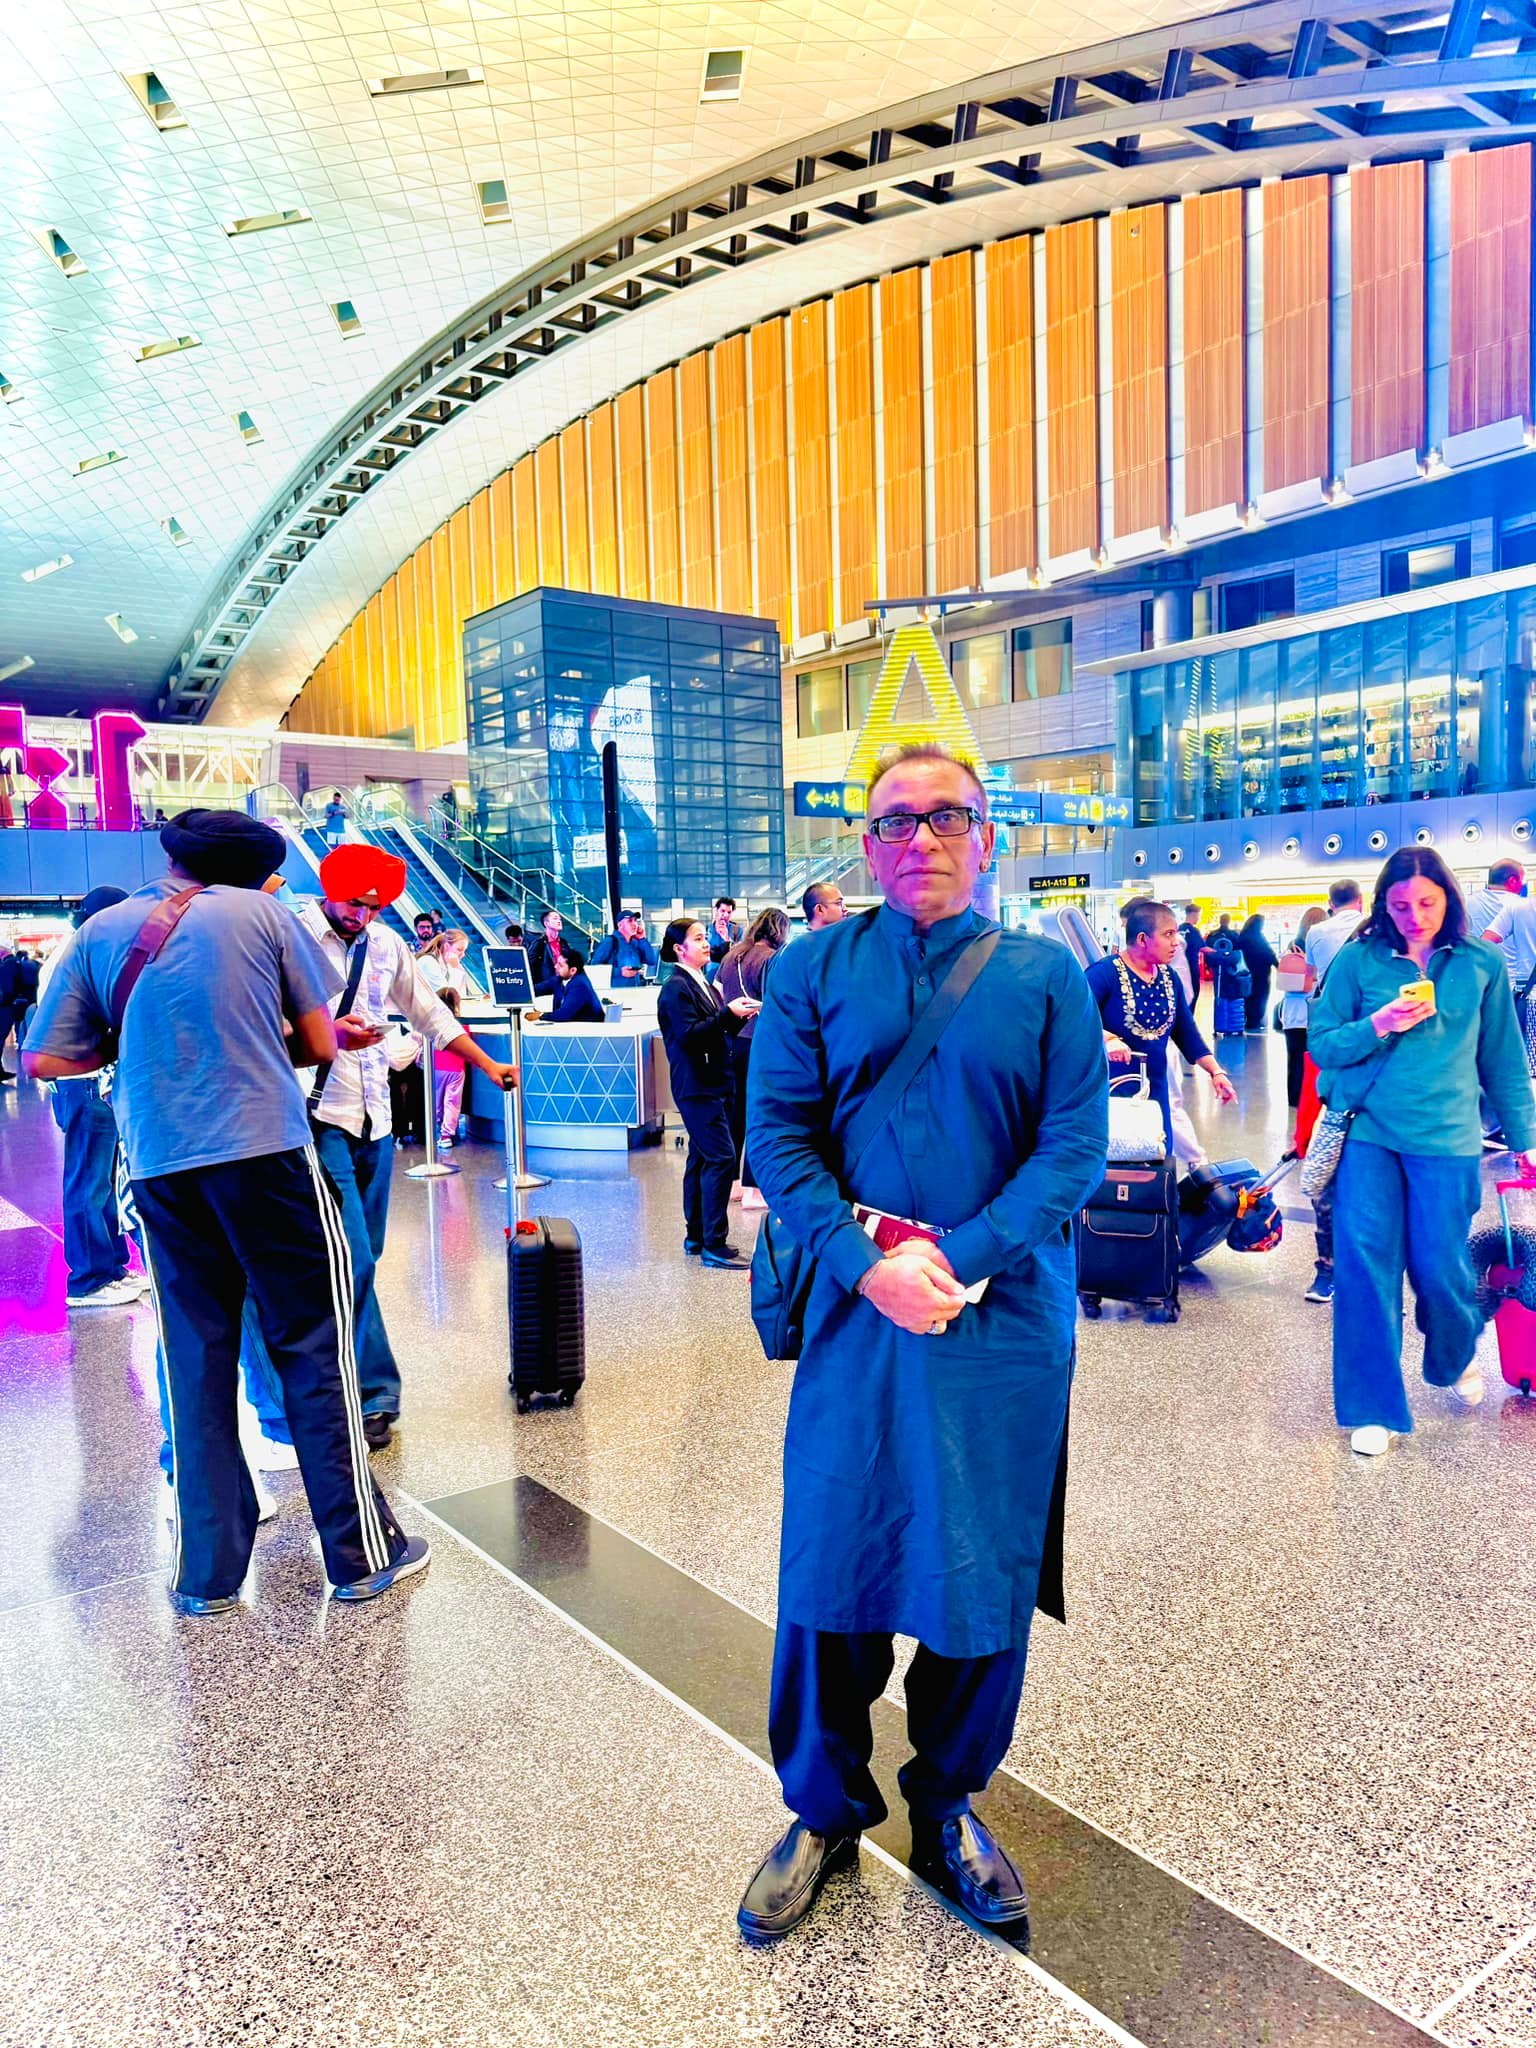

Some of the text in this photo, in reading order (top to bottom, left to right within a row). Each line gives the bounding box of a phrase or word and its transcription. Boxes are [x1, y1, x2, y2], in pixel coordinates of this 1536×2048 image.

[843, 624, 993, 783] A
[1078, 800, 1089, 818] A
[495, 976, 524, 986] No Entry
